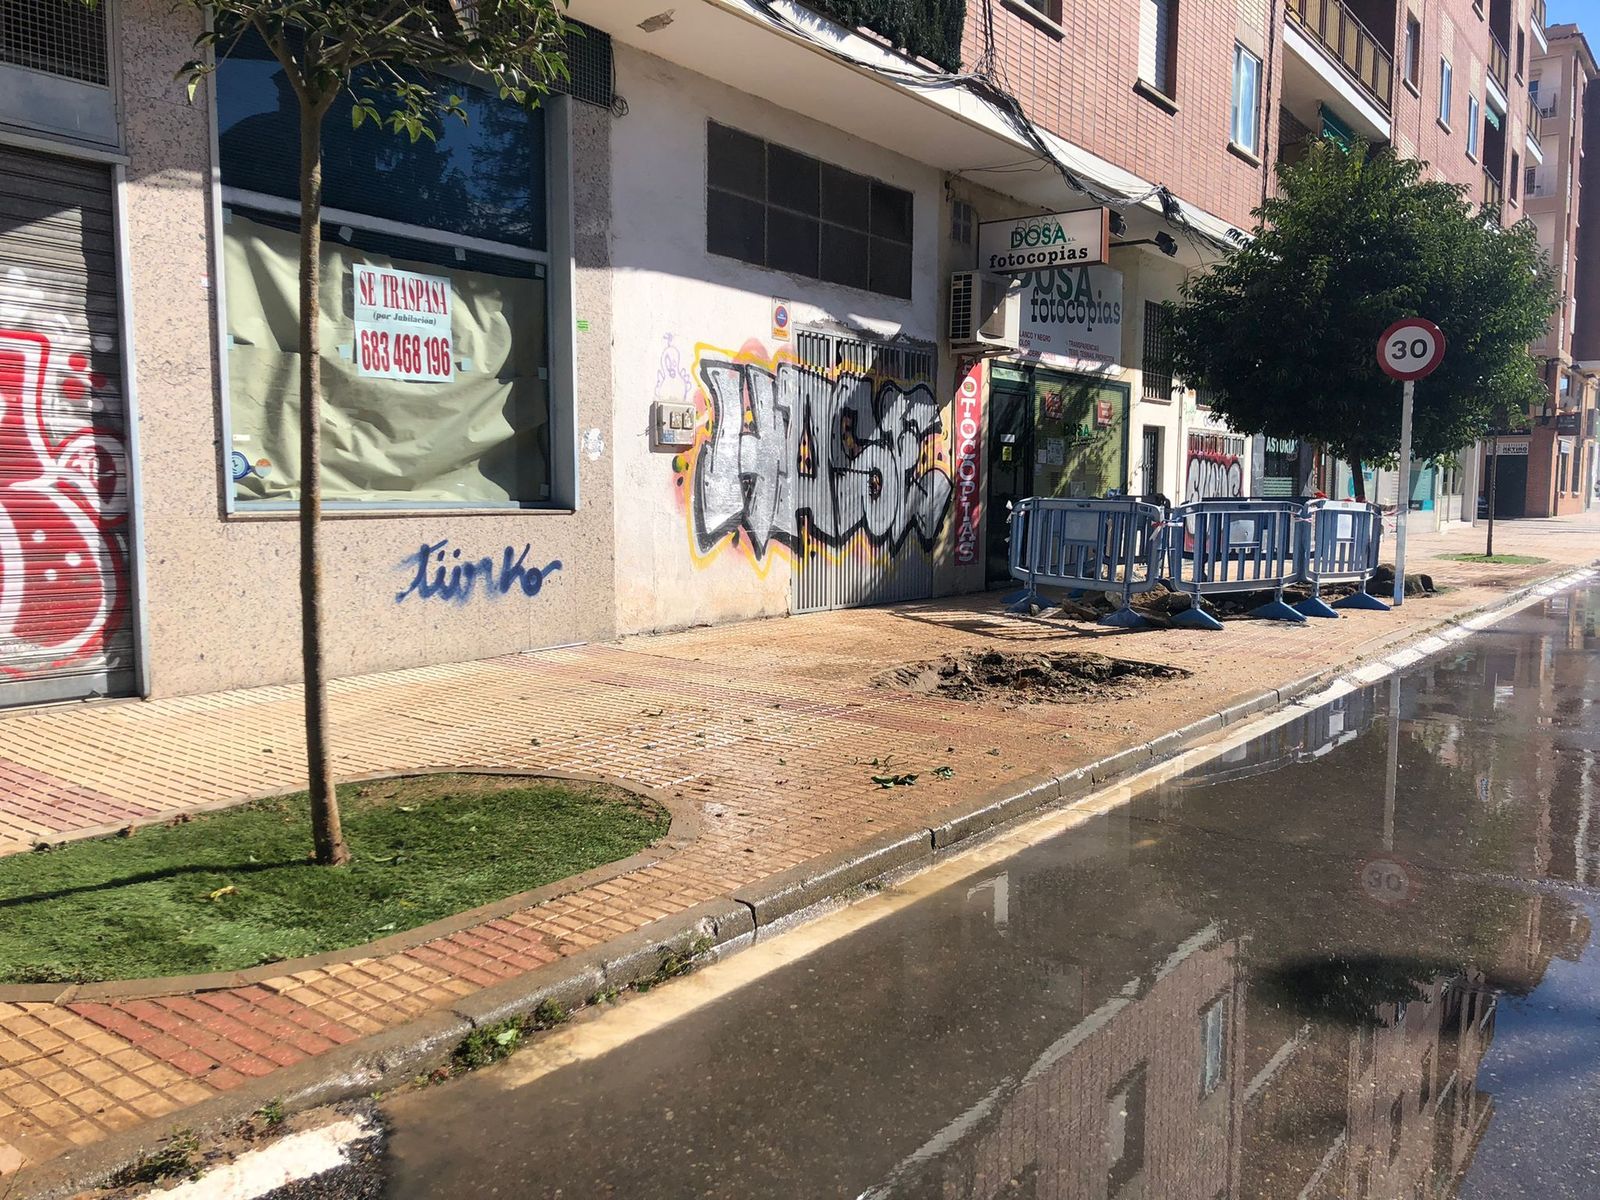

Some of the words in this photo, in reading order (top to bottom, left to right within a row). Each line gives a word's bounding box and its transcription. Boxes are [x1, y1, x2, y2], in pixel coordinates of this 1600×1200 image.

[1011, 220, 1067, 249] DOSA
[990, 246, 1088, 268] fotocopias
[360, 271, 376, 306] SE
[381, 275, 448, 315] TRASPASA
[373, 312, 391, 321] (por
[1031, 287, 1120, 331] fotocopias
[1019, 330, 1033, 339] LANCO
[361, 329, 390, 372] 683
[393, 333, 422, 374] 468
[424, 336, 451, 376] 196
[1392, 339, 1427, 360] 30
